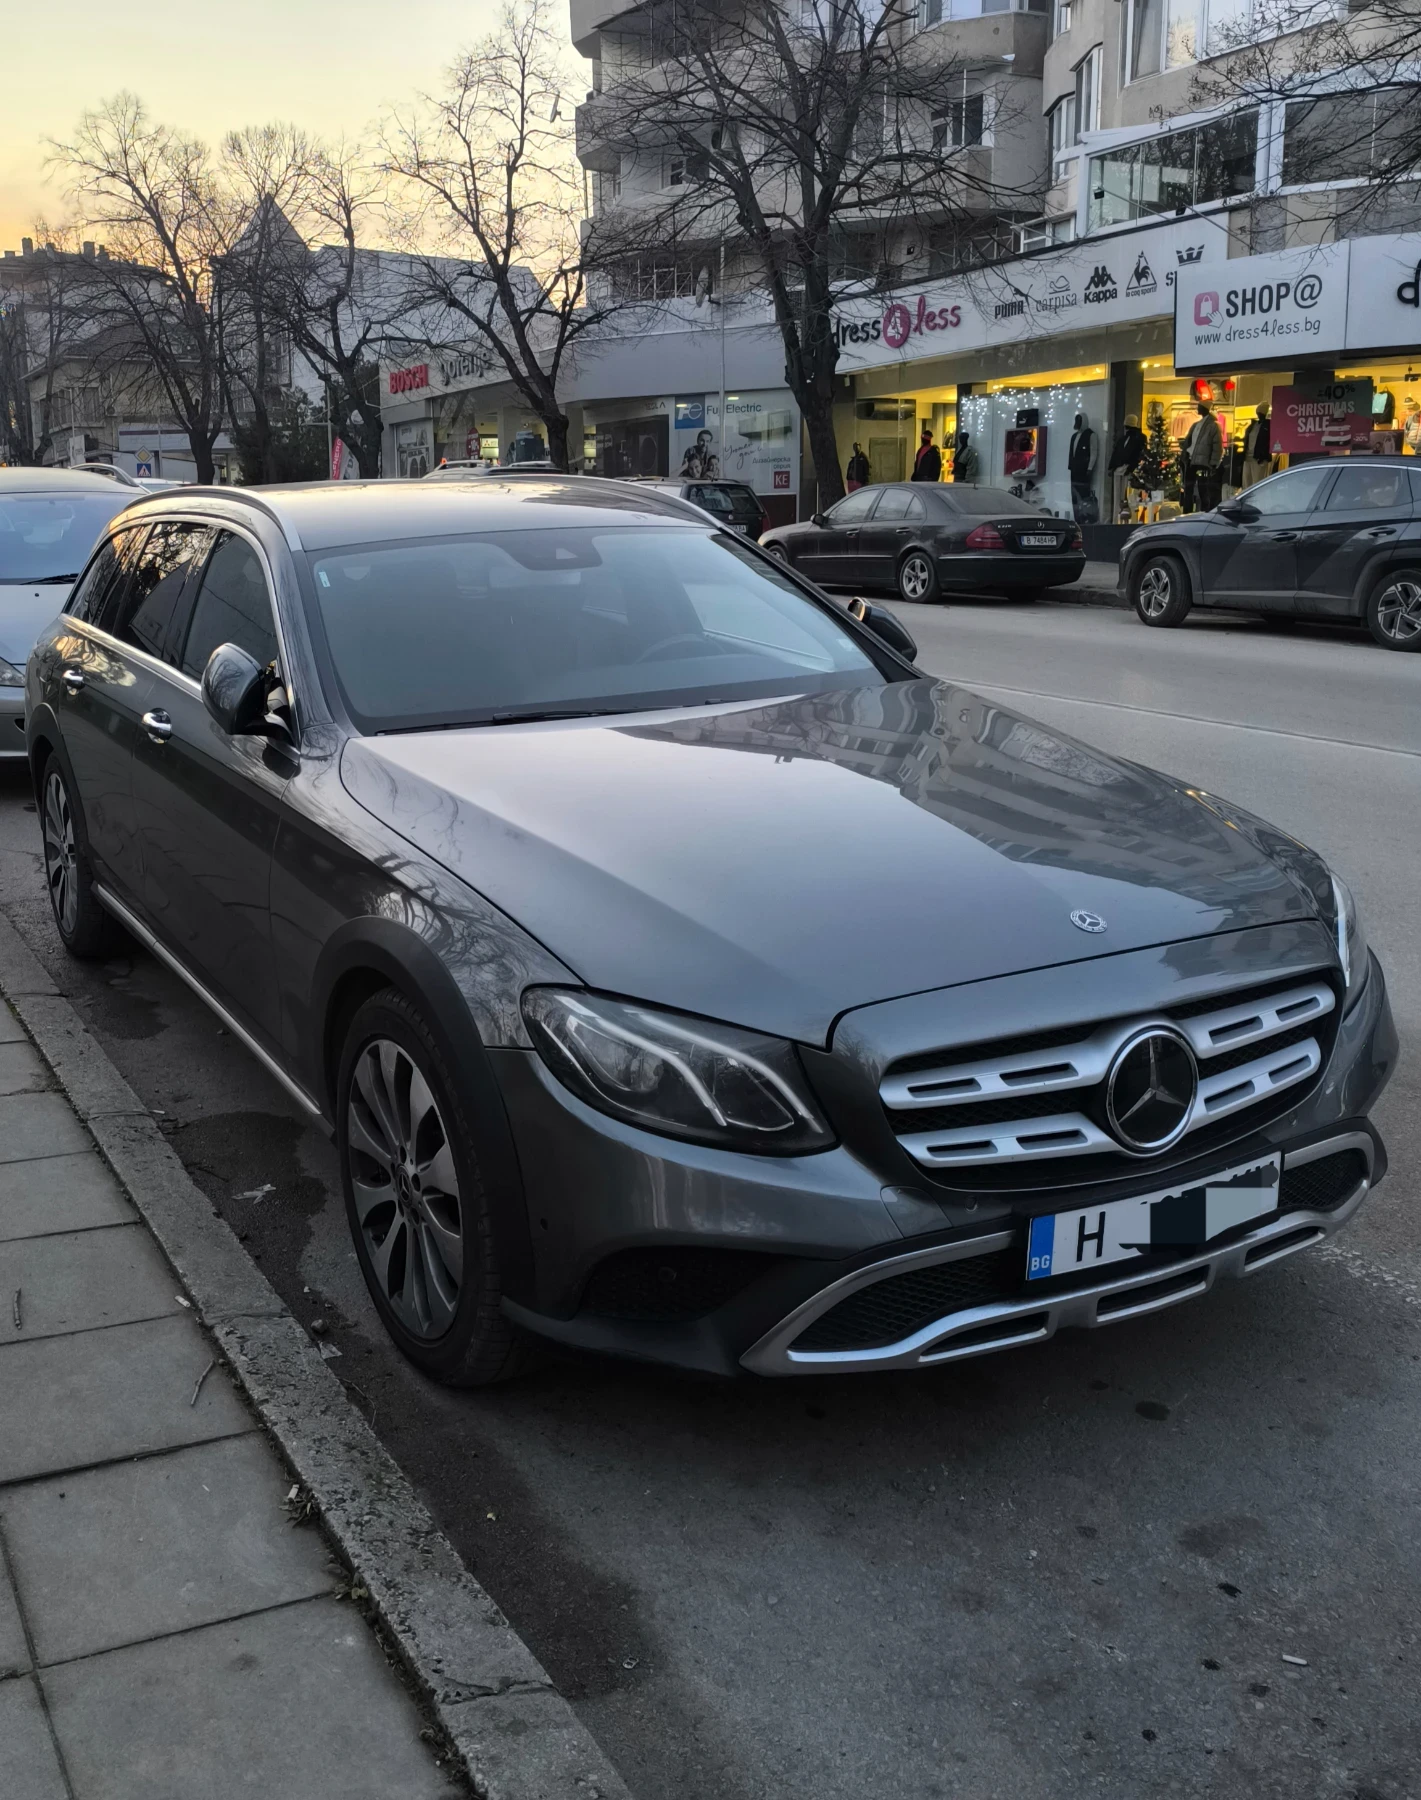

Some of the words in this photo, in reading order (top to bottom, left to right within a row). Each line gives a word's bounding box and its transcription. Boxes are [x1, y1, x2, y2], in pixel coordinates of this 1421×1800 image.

[1083, 287, 1118, 304] Kappa
[912, 294, 961, 335] less
[994, 299, 1024, 319] PUMA
[1194, 316, 1321, 345] www.dress4less.bg
[390, 363, 429, 394] BOSCH
[725, 402, 762, 414] Electric
[1286, 401, 1355, 417] CHRISTMAS
[1297, 416, 1330, 432] SALE
[775, 474, 789, 486] KE
[1031, 1255, 1050, 1271] BG
